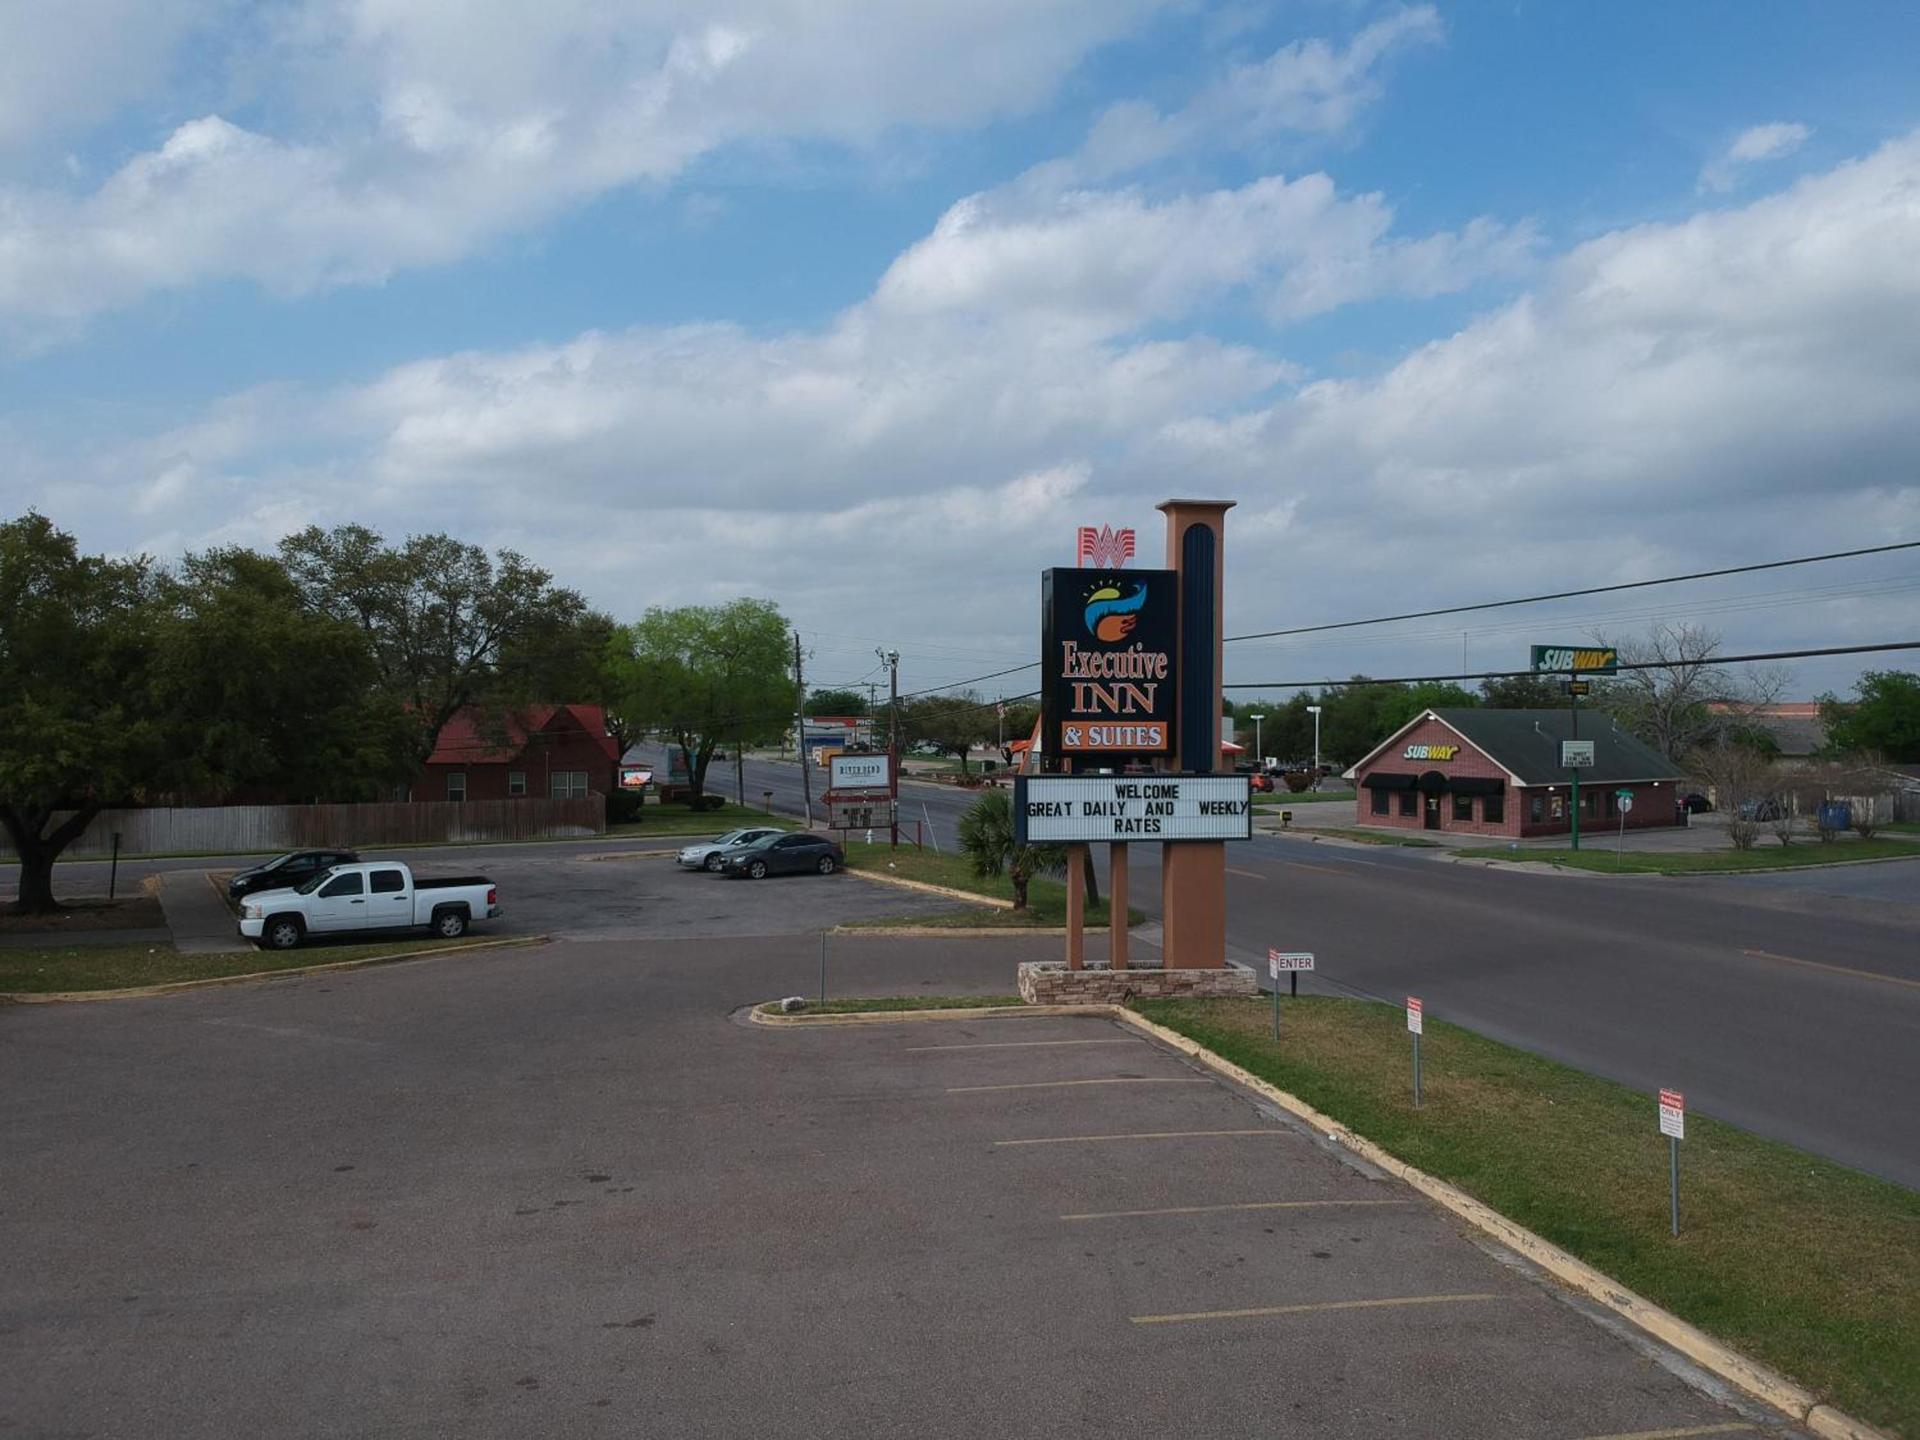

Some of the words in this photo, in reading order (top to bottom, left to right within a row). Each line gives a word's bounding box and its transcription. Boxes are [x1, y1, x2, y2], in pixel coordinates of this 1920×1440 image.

[1062, 640, 1168, 679] Executive
[1539, 649, 1614, 670] SUBWAY
[1071, 682, 1158, 714] INN
[1064, 726, 1082, 746] &
[1088, 726, 1161, 746] SUITES
[1403, 744, 1459, 759] SUBWAY
[1115, 784, 1180, 800] WELCOME
[1028, 802, 1073, 817] GREAT
[1083, 801, 1126, 817] DAILY
[1145, 801, 1175, 816] AND
[1199, 801, 1249, 816] WEEKLY
[1114, 818, 1161, 833] RATES
[1280, 957, 1312, 969] ENTER
